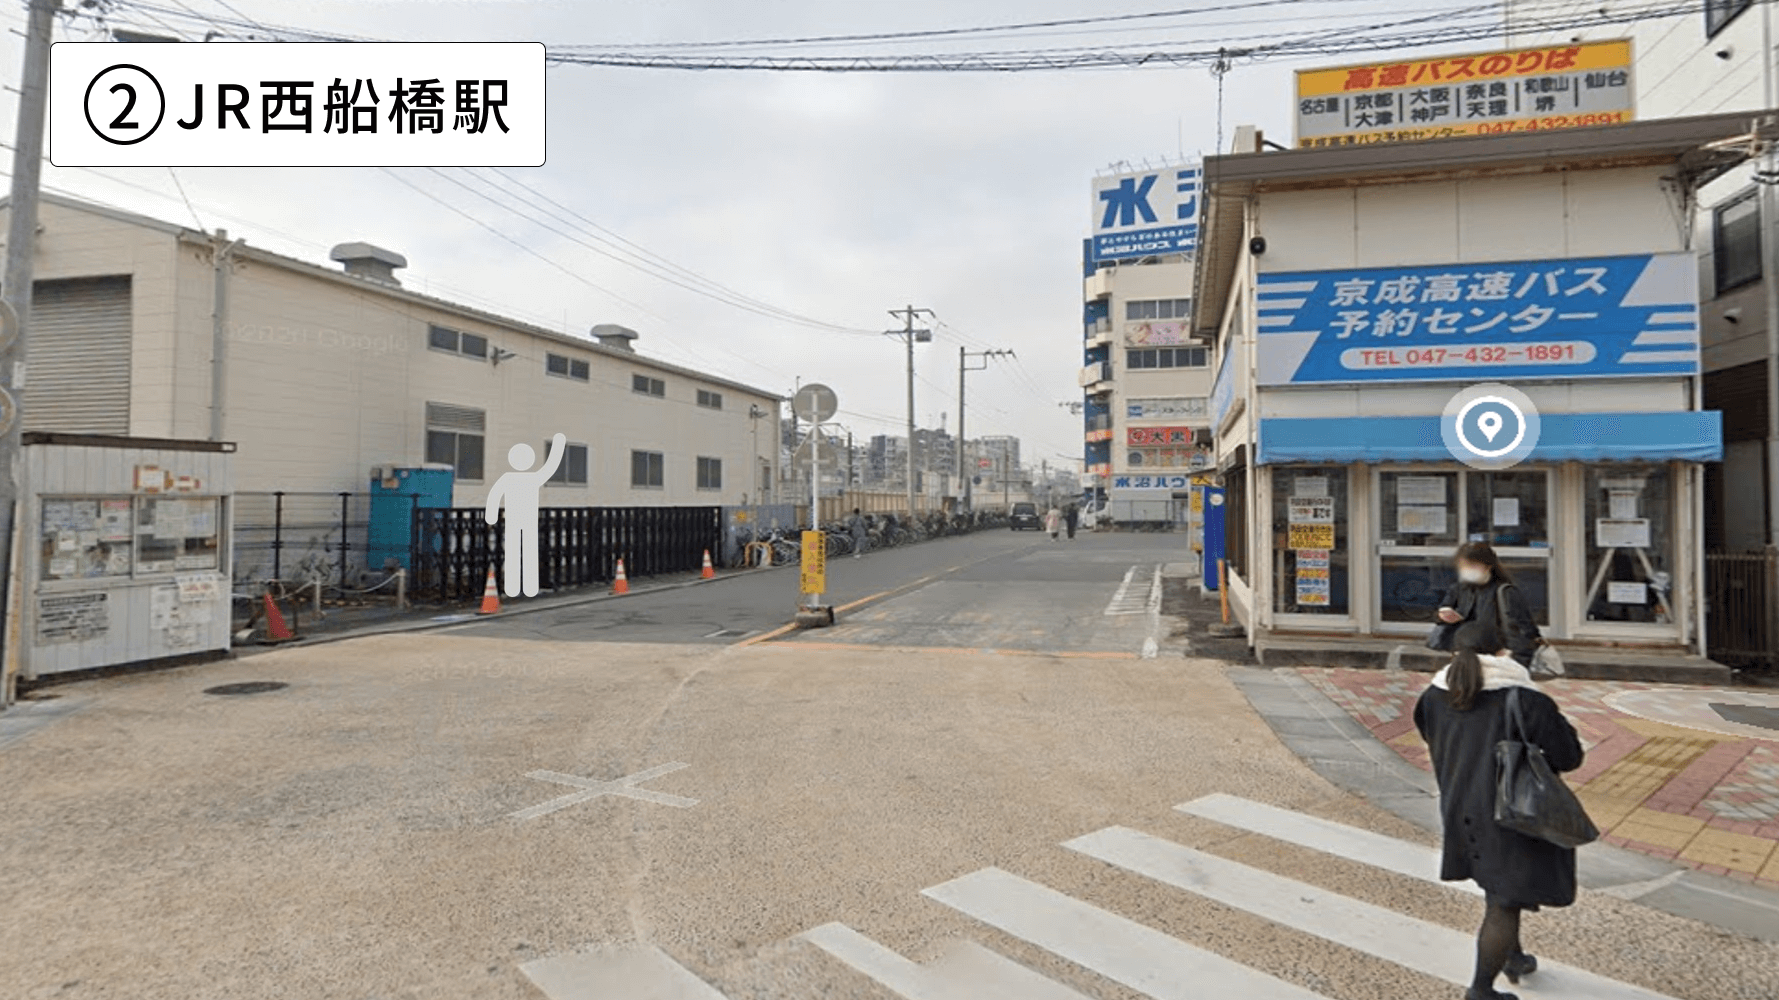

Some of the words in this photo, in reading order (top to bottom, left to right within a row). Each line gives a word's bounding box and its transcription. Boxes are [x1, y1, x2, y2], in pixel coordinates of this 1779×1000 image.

[1344, 46, 1582, 91] 高速バスのりば
[1300, 97, 1340, 115] 名古屋
[1355, 92, 1394, 110] 京都
[1409, 86, 1450, 105] 大阪
[1466, 81, 1507, 99] 奈良
[1524, 76, 1570, 95] 和歌山
[1585, 71, 1628, 89] 仙台
[1355, 110, 1394, 129] 大津
[1410, 105, 1450, 124] 神戸
[1466, 98, 1508, 118] 天理
[1478, 111, 1622, 136] 047-432-1891
[1328, 267, 1609, 306] 京成高速バス
[1330, 304, 1598, 339] 予約センター
[1361, 349, 1401, 366] TEL
[1406, 344, 1575, 365] 047-432-1891
